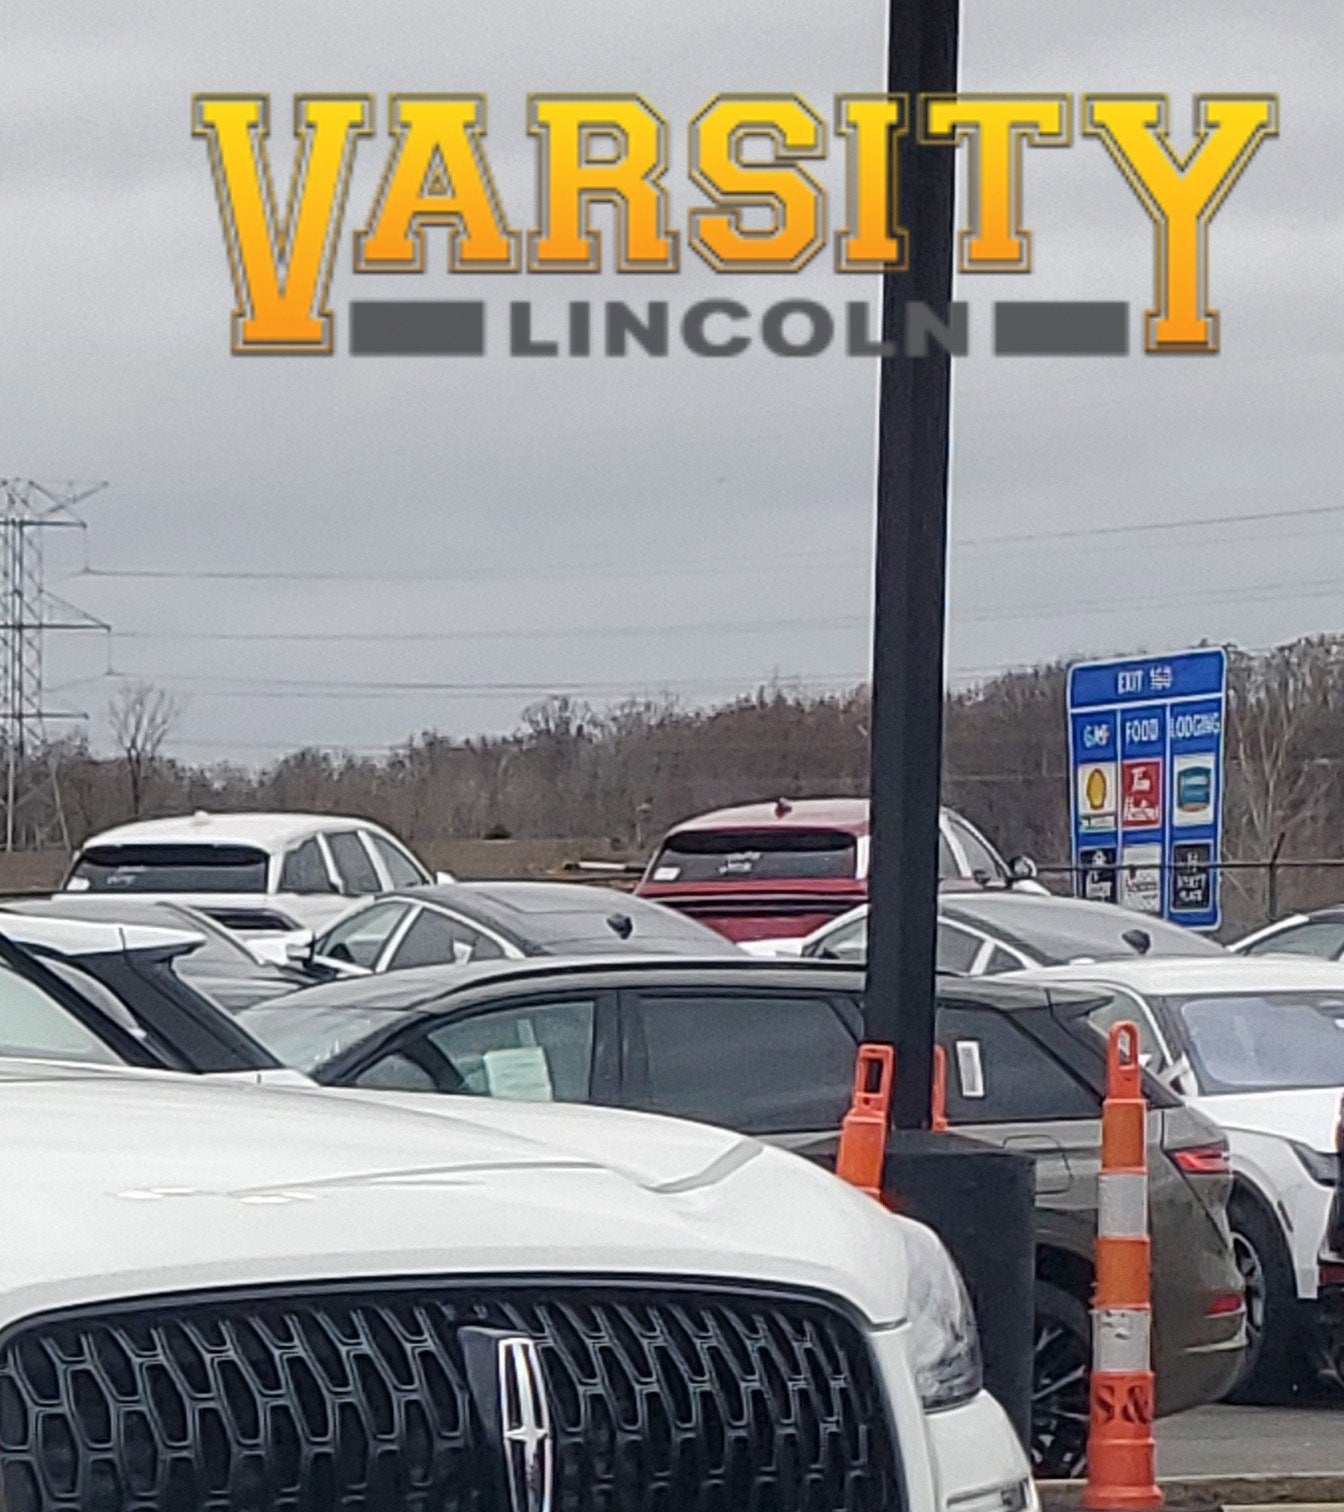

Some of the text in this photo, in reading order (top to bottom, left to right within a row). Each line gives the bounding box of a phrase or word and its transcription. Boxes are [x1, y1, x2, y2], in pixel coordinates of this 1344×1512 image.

[1117, 669, 1143, 694] EXIT
[1125, 718, 1159, 743] FOOD
[1170, 711, 1220, 738] LODGING
